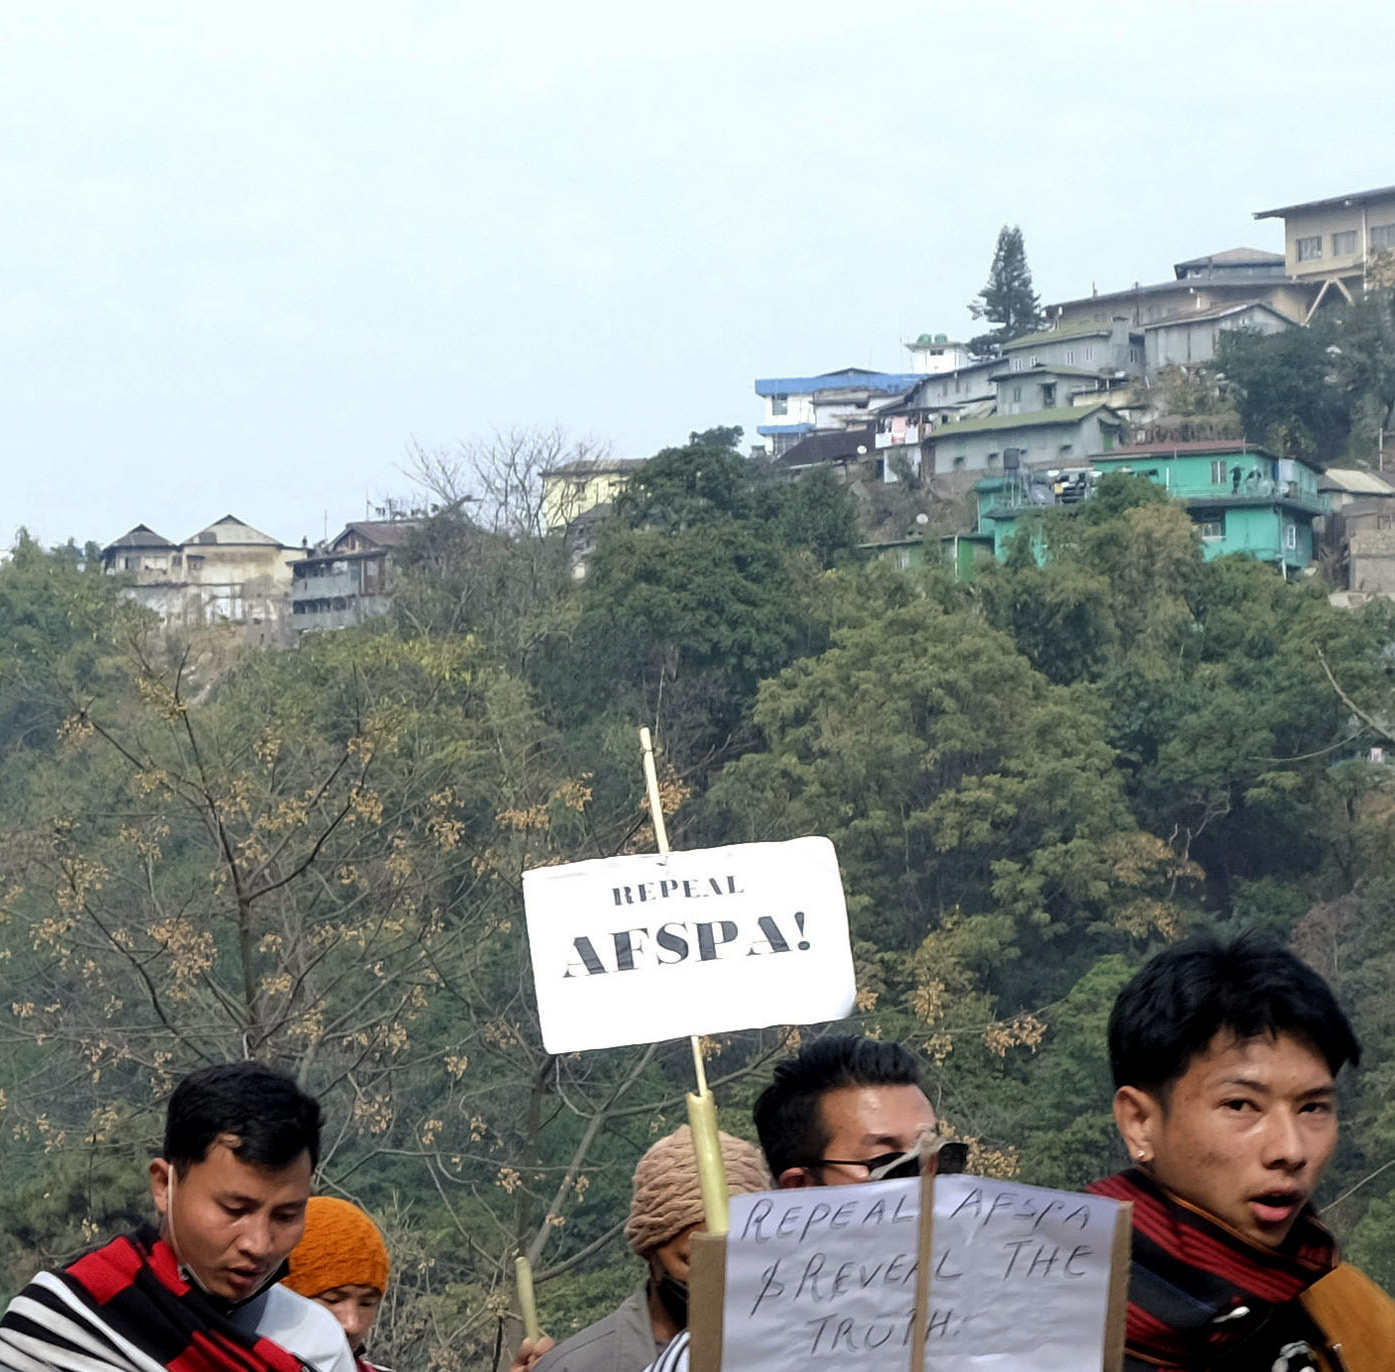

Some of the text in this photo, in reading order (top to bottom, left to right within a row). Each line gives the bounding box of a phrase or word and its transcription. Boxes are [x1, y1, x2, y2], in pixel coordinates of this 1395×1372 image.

[611, 875, 745, 906] REPEAL
[562, 911, 811, 979] AFSPA!
[741, 1187, 1091, 1244] REPEAL AFSPA
[1003, 1238, 1097, 1281] THE
